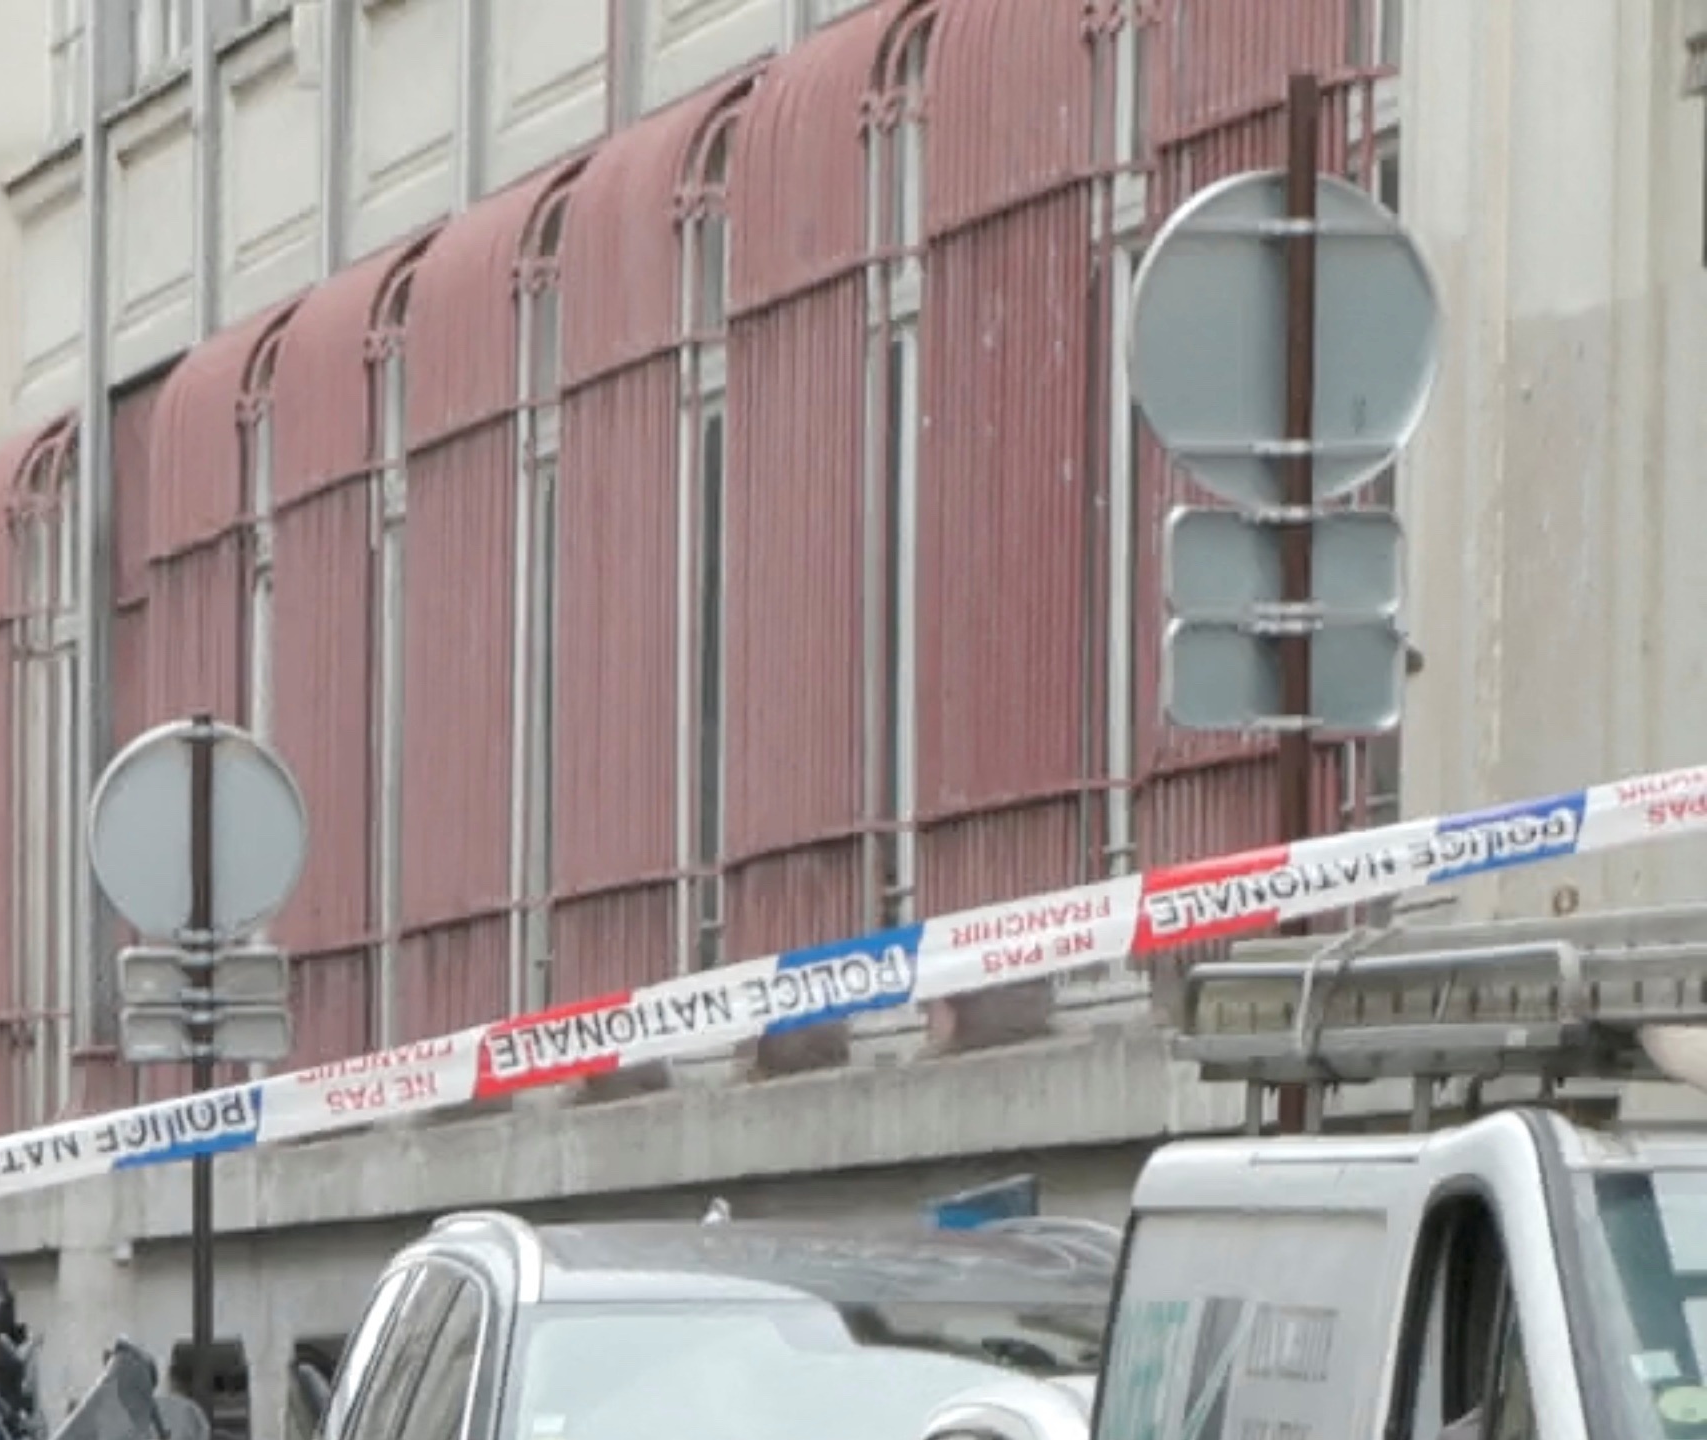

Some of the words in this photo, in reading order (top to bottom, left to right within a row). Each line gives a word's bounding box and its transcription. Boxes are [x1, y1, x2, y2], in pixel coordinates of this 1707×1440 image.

[1409, 808, 1580, 868] POLICE
[950, 894, 1112, 949] FRANCHIR
[1149, 854, 1397, 930] NATIONALE
[982, 943, 1038, 973] PAS
[1052, 931, 1096, 961] NE
[746, 945, 911, 1020] POLICE
[489, 988, 733, 1070] NATIONALE
[94, 1091, 248, 1153] POLICE
[324, 1080, 386, 1114] PAS
